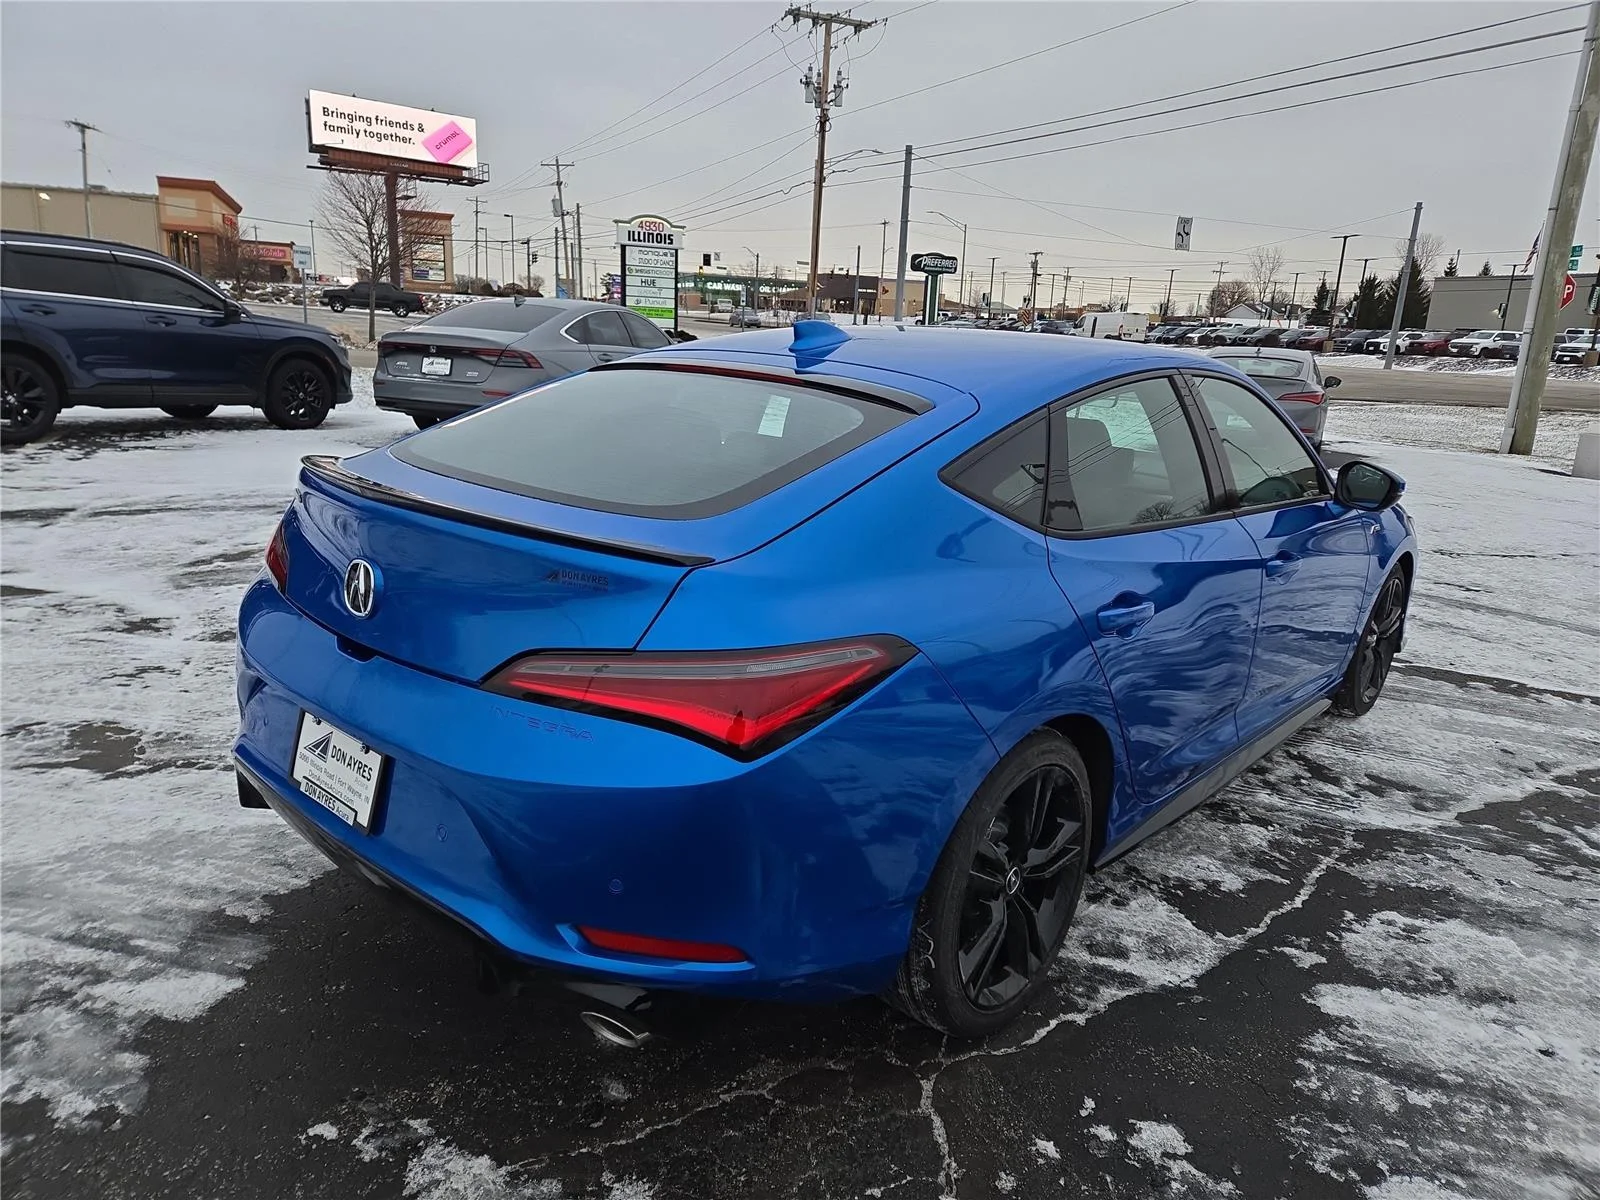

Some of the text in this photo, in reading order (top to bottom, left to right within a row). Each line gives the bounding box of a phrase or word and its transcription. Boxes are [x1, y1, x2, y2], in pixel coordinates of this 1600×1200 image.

[322, 106, 425, 133] Bringing friends &
[323, 121, 416, 145] family together.
[435, 130, 459, 150] crumbl
[638, 220, 664, 232] 4930
[628, 230, 674, 245] ILLINOIS
[921, 256, 957, 268] PREFERRED
[640, 278, 656, 286] HUE
[707, 282, 724, 290] CAR
[562, 570, 608, 586] DON AYRES
[490, 706, 594, 742] INTEGRA
[331, 744, 373, 781] DON AYRES
[324, 767, 334, 781] Road
[338, 776, 346, 788] Fort
[355, 776, 368, 790] Acura
[304, 782, 349, 821] DON AYRES Acura
